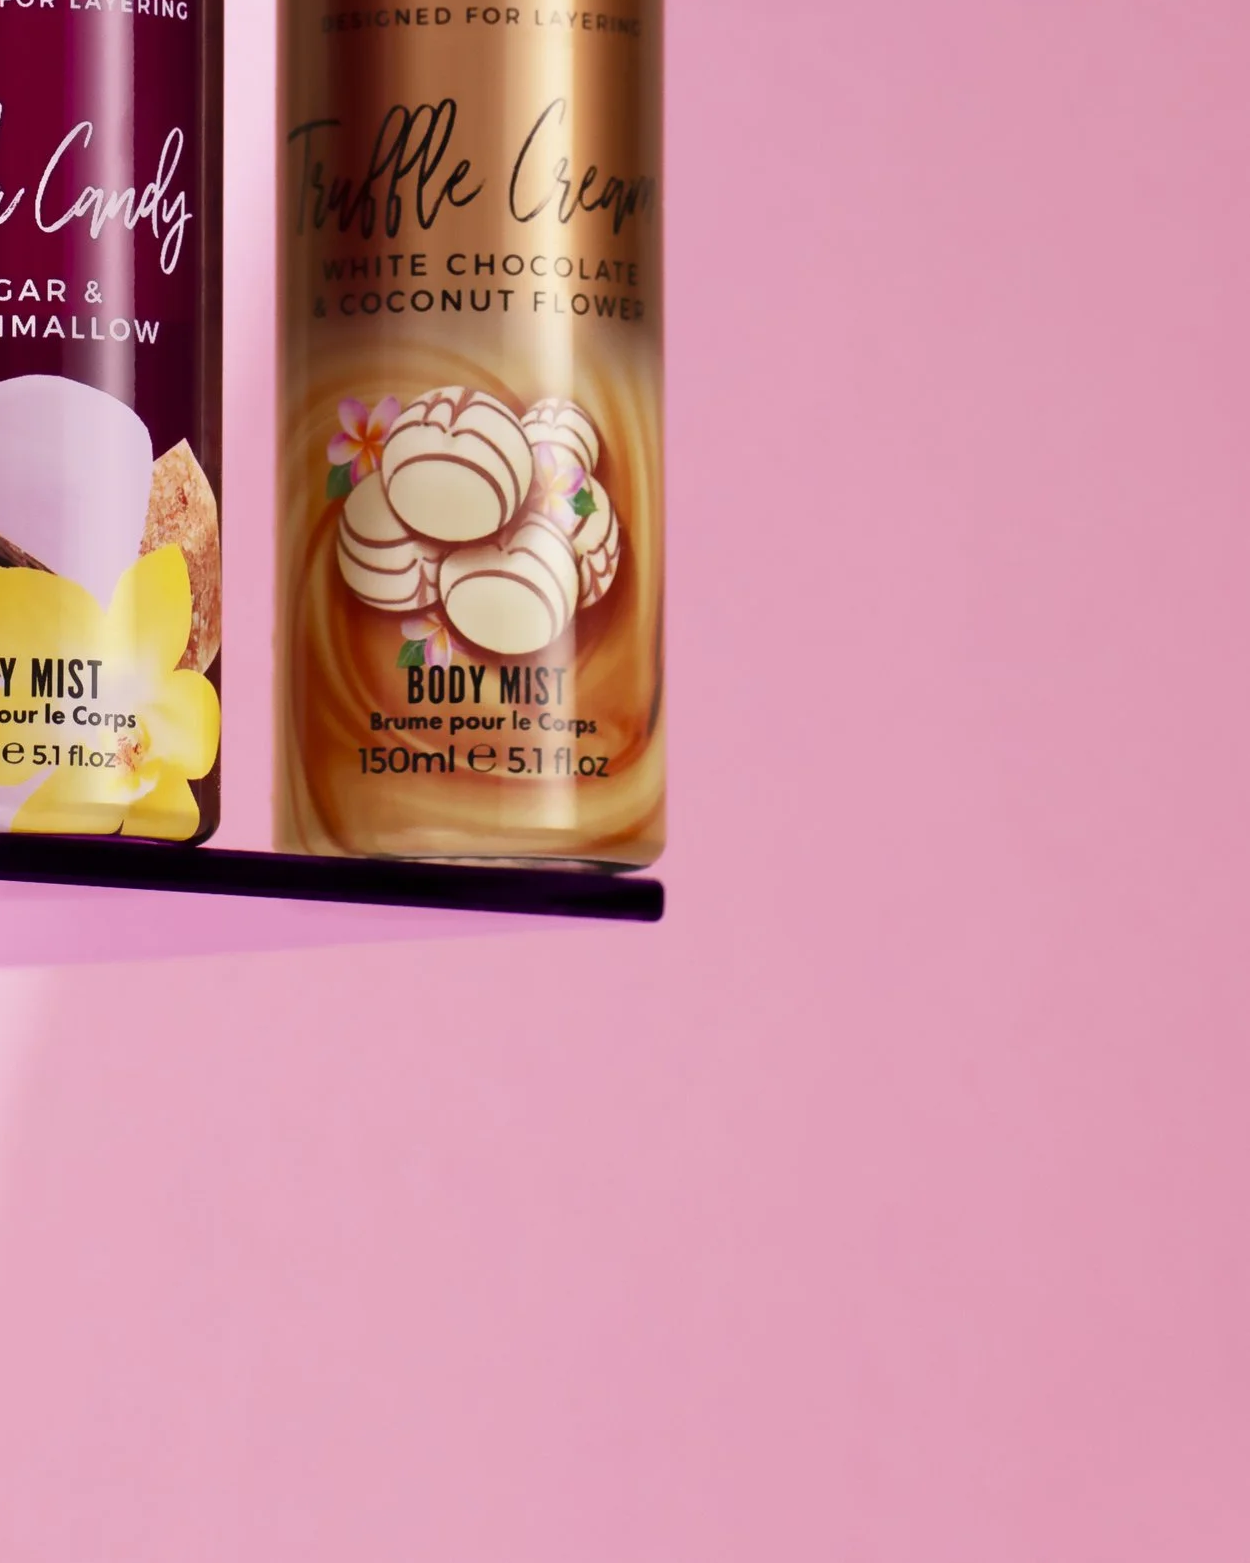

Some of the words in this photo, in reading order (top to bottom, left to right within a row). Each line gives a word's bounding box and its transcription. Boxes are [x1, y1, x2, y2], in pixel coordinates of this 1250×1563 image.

[321, 8, 451, 35] DESIGNED
[466, 7, 520, 25] FOR
[534, 9, 642, 37] LAYERING
[287, 97, 486, 239] Truffle
[34, 121, 193, 275] Candy
[322, 253, 428, 281] WHITE
[446, 253, 638, 286] CHOCOLATE
[84, 280, 103, 304] &
[313, 296, 327, 318] &
[340, 289, 515, 315] COCONUT
[533, 291, 645, 322] FLOWER
[31, 659, 102, 699] MIST
[407, 665, 486, 705] BODY
[499, 666, 567, 706] MIST
[44, 705, 66, 725] le
[72, 706, 138, 732] Corps
[370, 713, 443, 732] Brume
[449, 715, 506, 738] pour
[511, 712, 532, 732] le
[537, 713, 597, 738] Corps
[32, 745, 60, 766] 5.1
[68, 745, 116, 768] fl.oz
[358, 745, 455, 774] 150ml
[507, 747, 543, 774] 5.1
[553, 747, 610, 778] fl.oz
